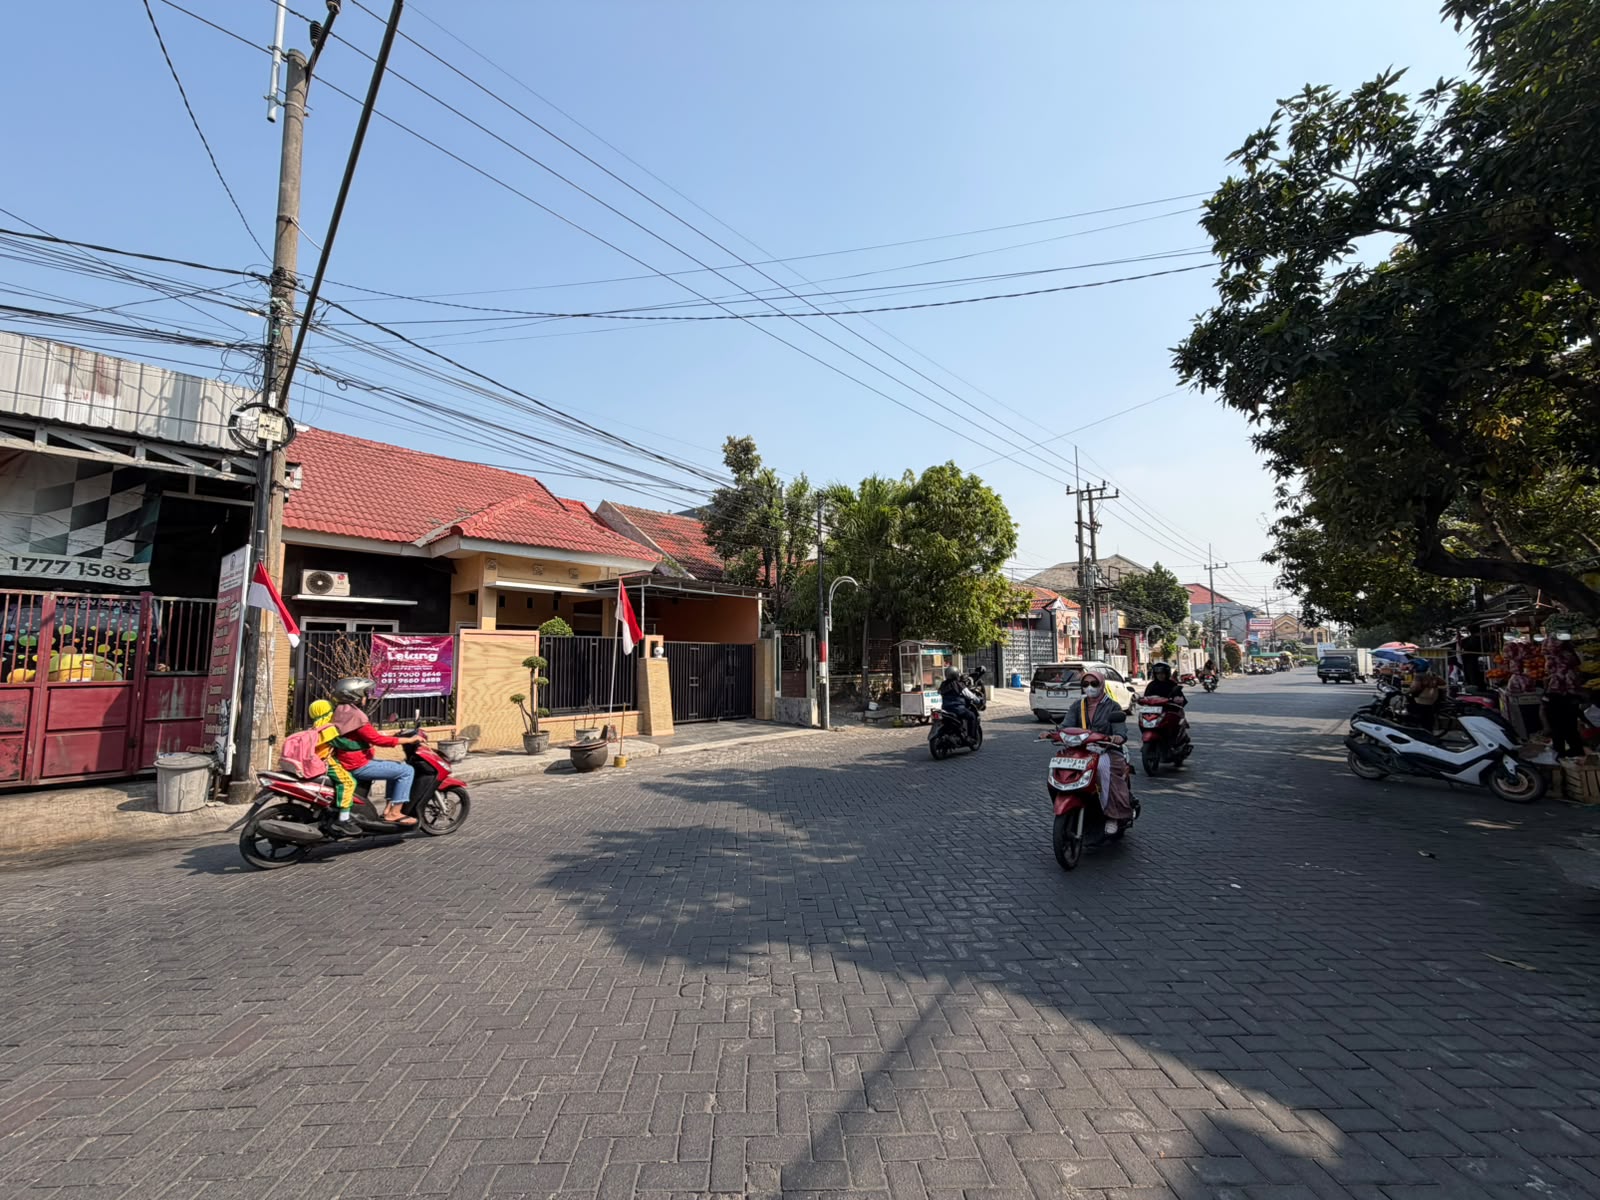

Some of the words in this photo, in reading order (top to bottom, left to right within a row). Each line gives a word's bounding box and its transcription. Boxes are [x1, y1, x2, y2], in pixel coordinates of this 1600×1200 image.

[10, 557, 71, 574] 1777
[77, 562, 131, 580] 1588
[387, 651, 438, 662] Lelang
